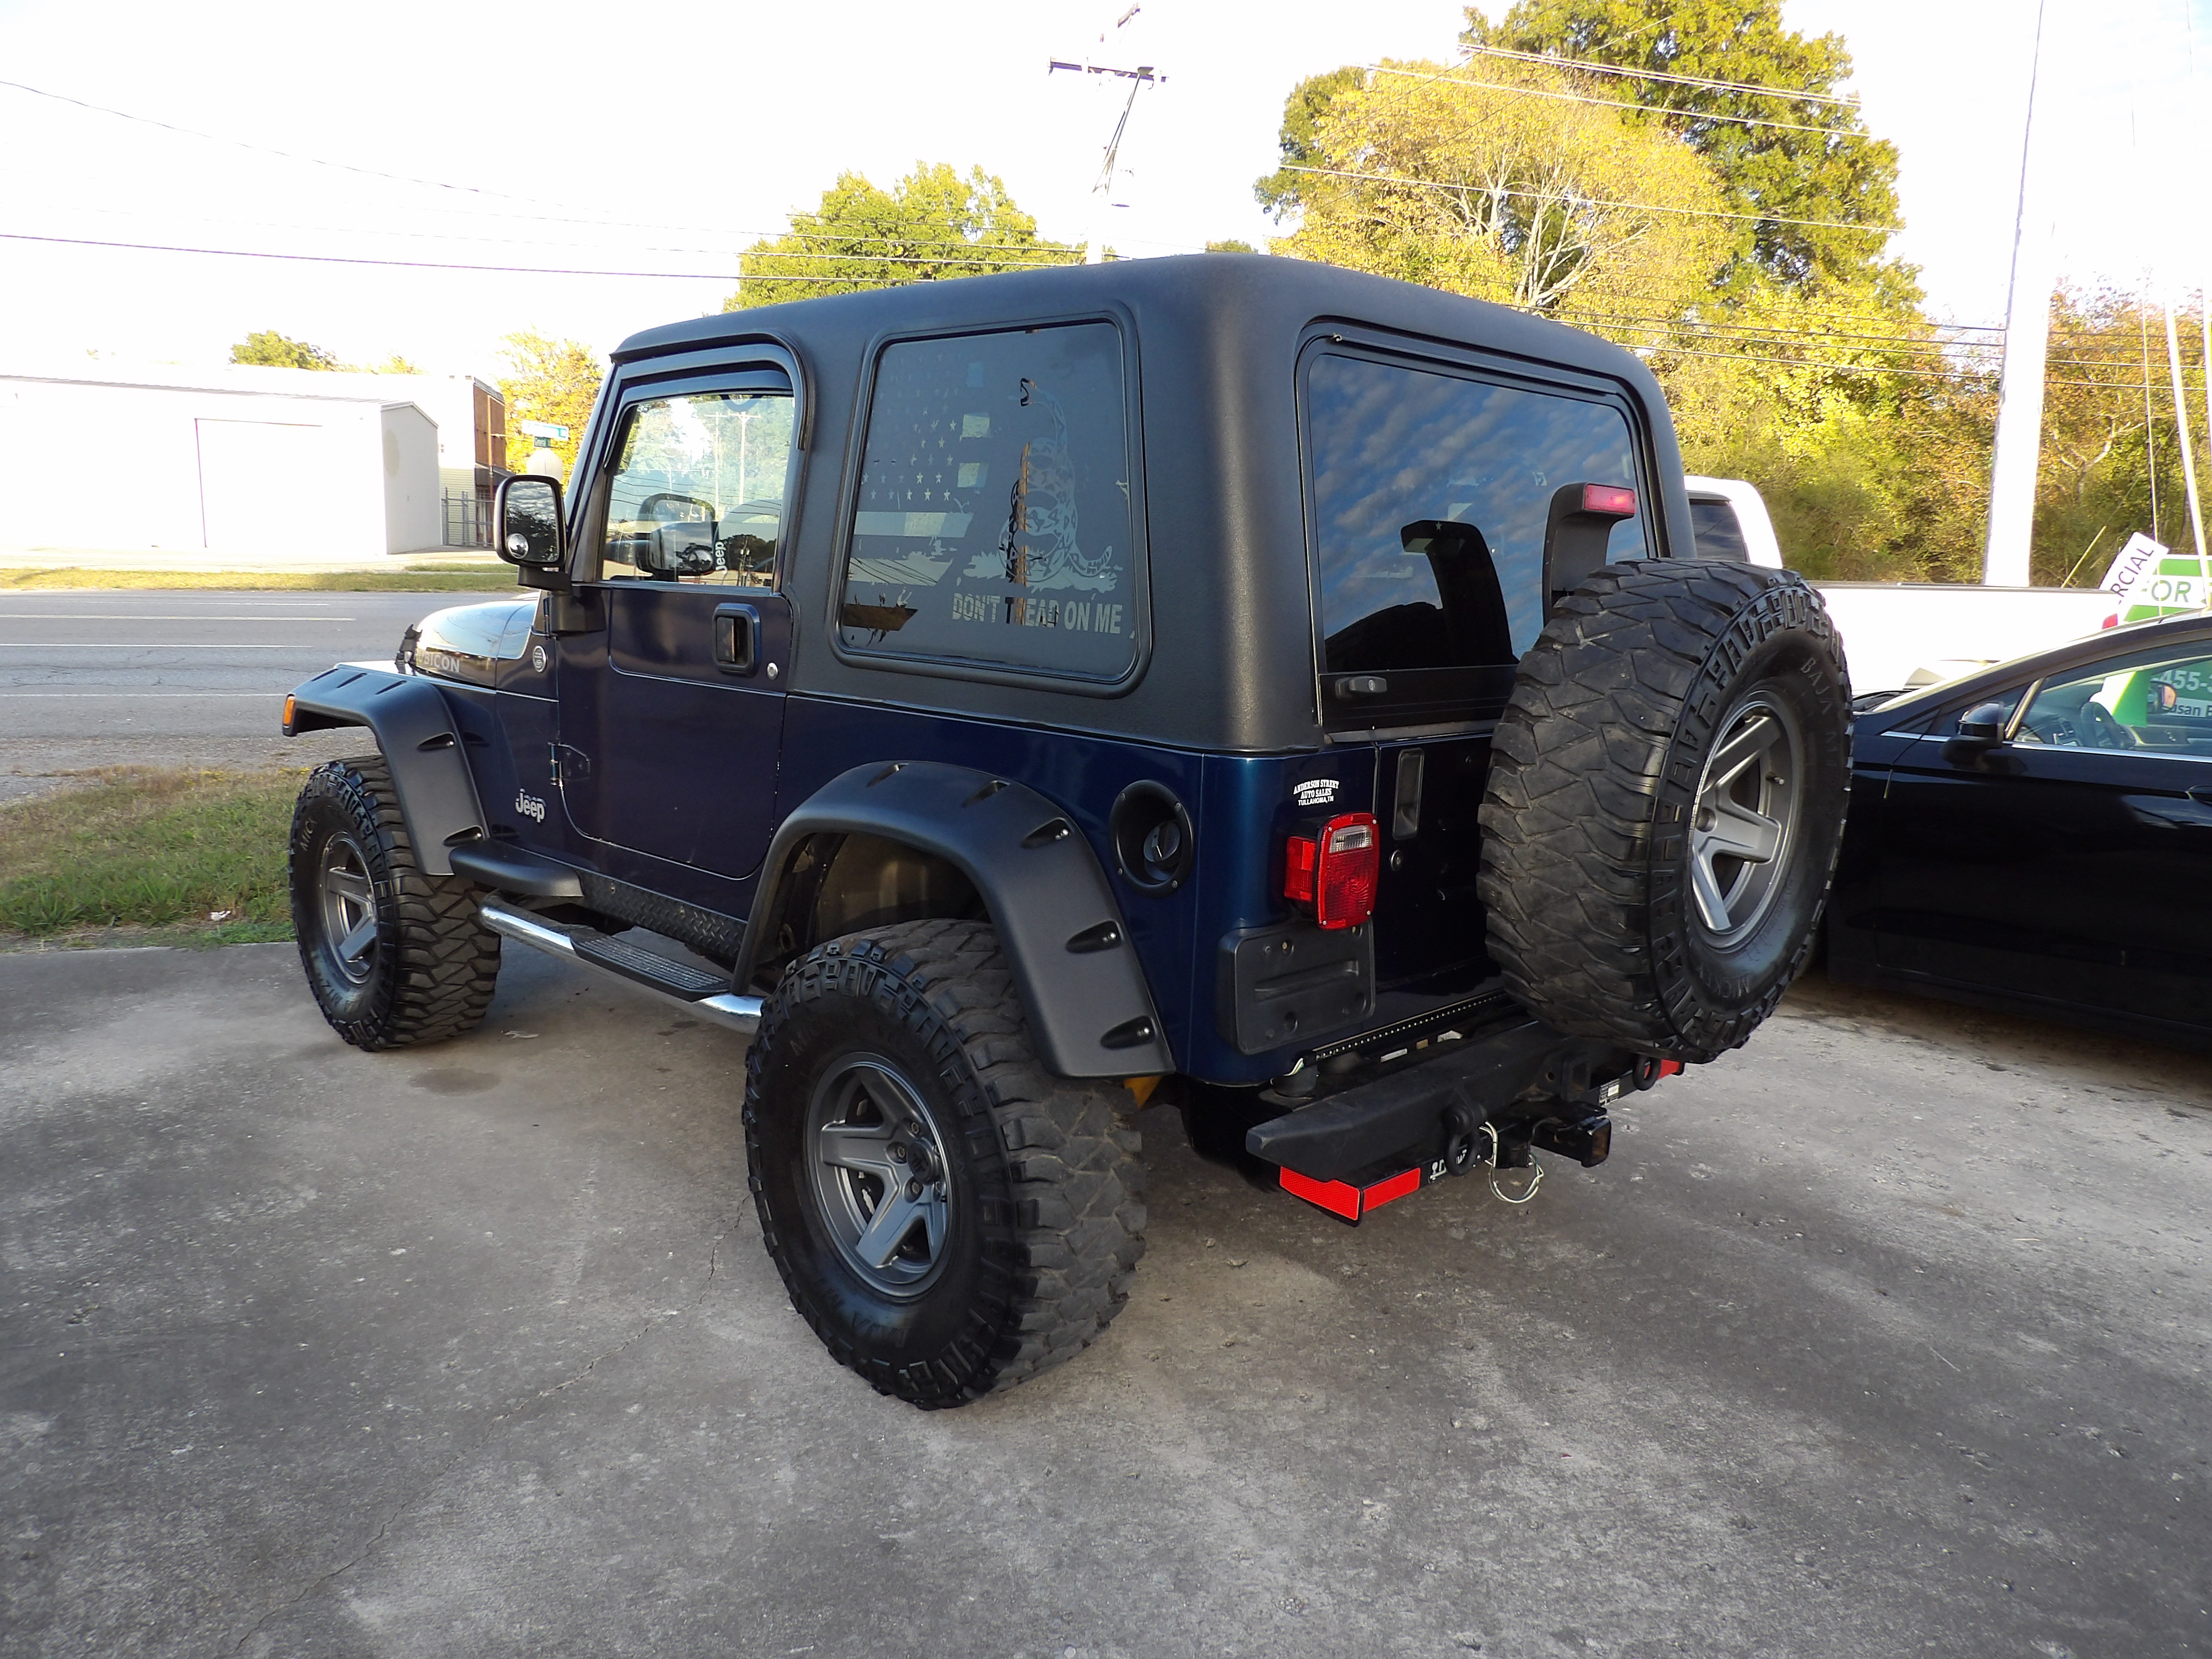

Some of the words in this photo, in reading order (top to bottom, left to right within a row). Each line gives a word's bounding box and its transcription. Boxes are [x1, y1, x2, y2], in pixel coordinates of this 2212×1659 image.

[715, 541, 728, 575] Jeep
[2110, 549, 2154, 598] RCIAL
[2141, 579, 2191, 602] OR
[952, 593, 1001, 623] DON'T
[1005, 597, 1059, 627] TREAD
[1064, 601, 1091, 631] ON
[1094, 603, 1123, 634] ME
[1293, 780, 1320, 794] ANDERSON
[1320, 779, 1339, 789] STREET
[1300, 790, 1315, 799] AUTO
[1315, 788, 1332, 797] SALES
[515, 788, 546, 823] Jeep
